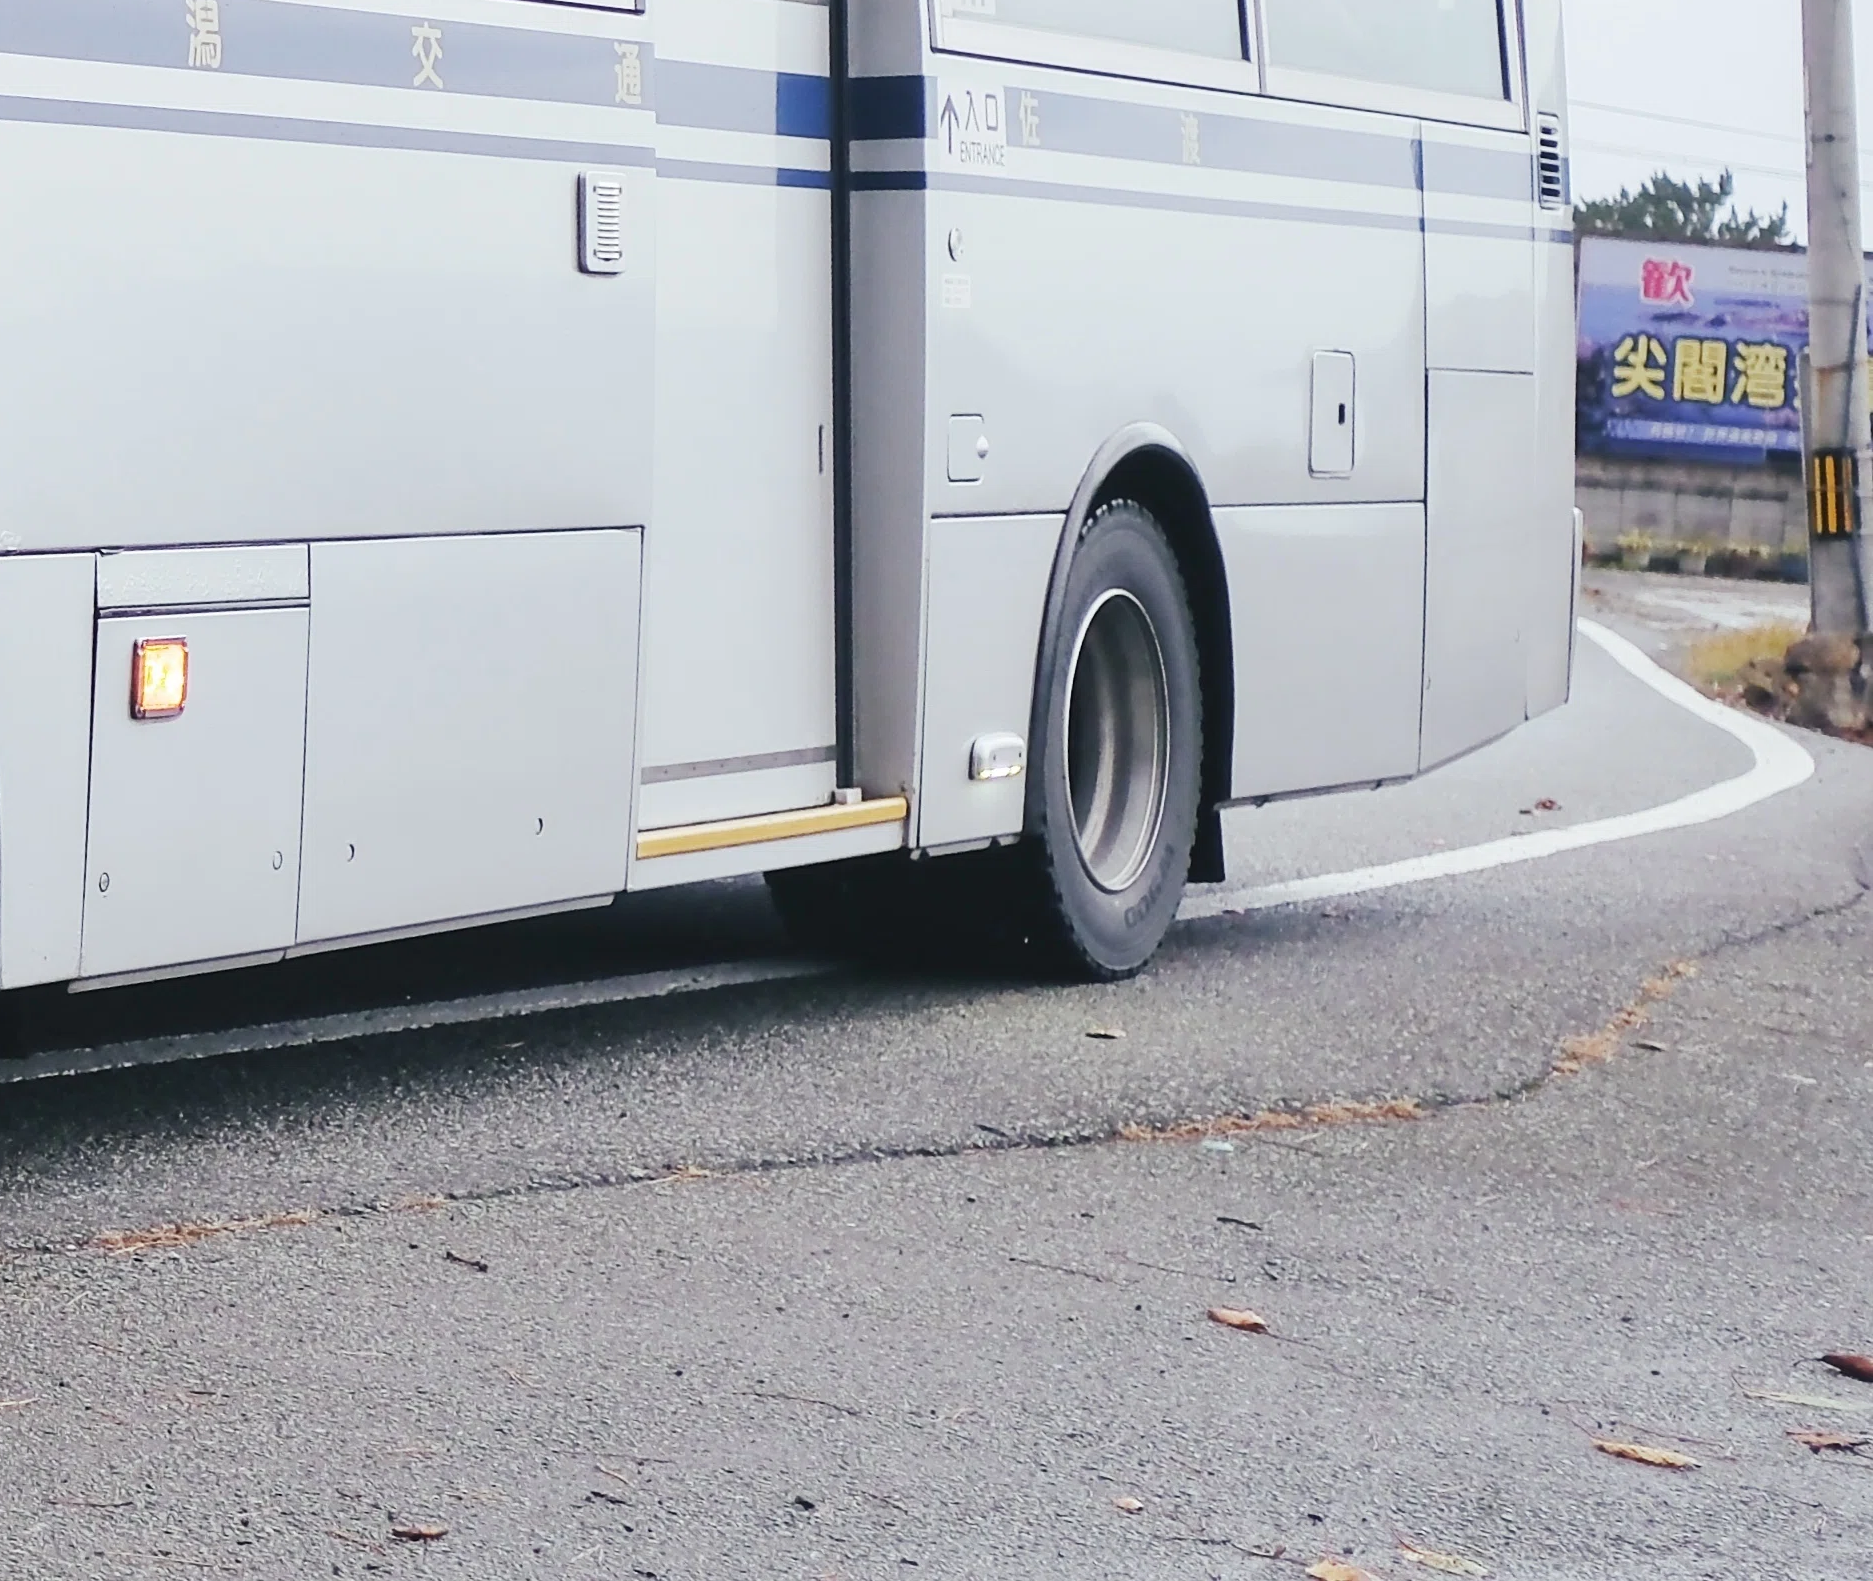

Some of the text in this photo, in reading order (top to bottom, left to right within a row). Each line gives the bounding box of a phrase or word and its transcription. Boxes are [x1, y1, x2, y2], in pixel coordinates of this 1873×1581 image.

[965, 90, 999, 132] 入口
[960, 141, 1006, 167] ENTRANCE
[1610, 333, 1810, 410] 尖閣湾
